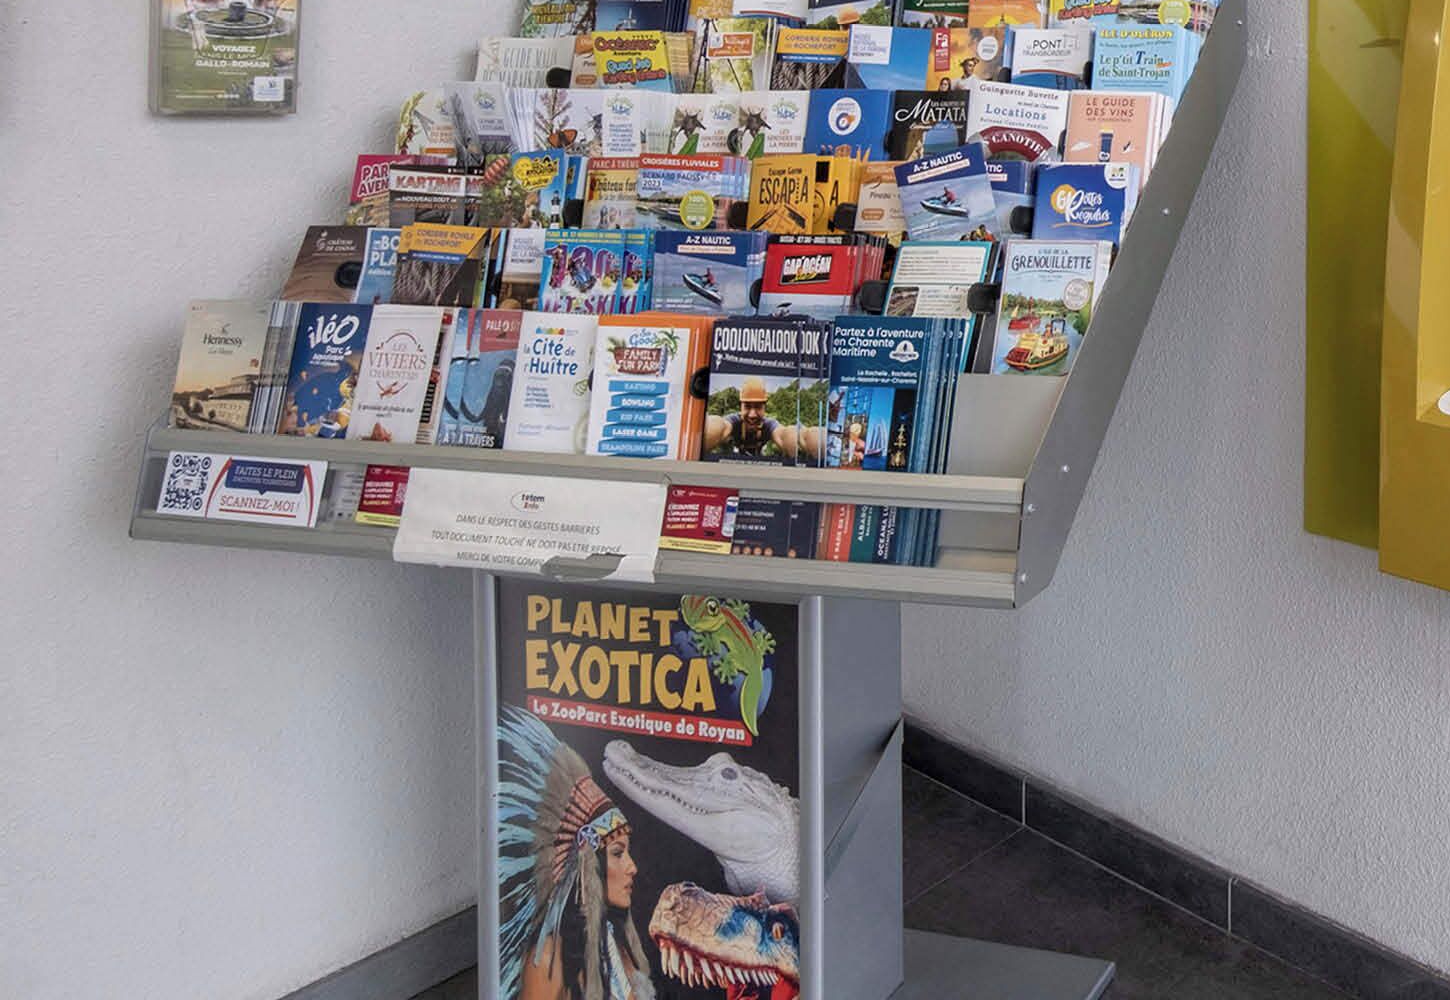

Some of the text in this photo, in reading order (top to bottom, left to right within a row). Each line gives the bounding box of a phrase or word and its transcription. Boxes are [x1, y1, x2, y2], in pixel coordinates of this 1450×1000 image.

[1099, 50, 1164, 66] Le Train
[1098, 67, 1111, 78] de
[894, 97, 968, 123] MATATA
[1085, 98, 1136, 107] LE GUIDE
[985, 103, 1048, 121] Locations
[1085, 107, 1135, 117] DES VINS
[912, 151, 964, 173] A-Z NAUTIC
[395, 175, 462, 193] KARTING
[834, 326, 865, 338] Partez
[876, 326, 925, 338] l'aventure
[202, 333, 243, 348] Hennessy
[533, 338, 564, 356] Cité
[833, 336, 895, 348] en Charente
[833, 346, 877, 358] Maritime
[367, 352, 427, 370] VIVIERS
[233, 465, 261, 477] FAITES
[273, 468, 299, 480] PLEIN
[456, 514, 477, 524] DANS
[488, 517, 517, 529] RESPECT
[526, 594, 679, 647] PLANET
[525, 639, 717, 713] EXOTICA
[532, 699, 747, 745] Le ZooParc Exotique de Royan
